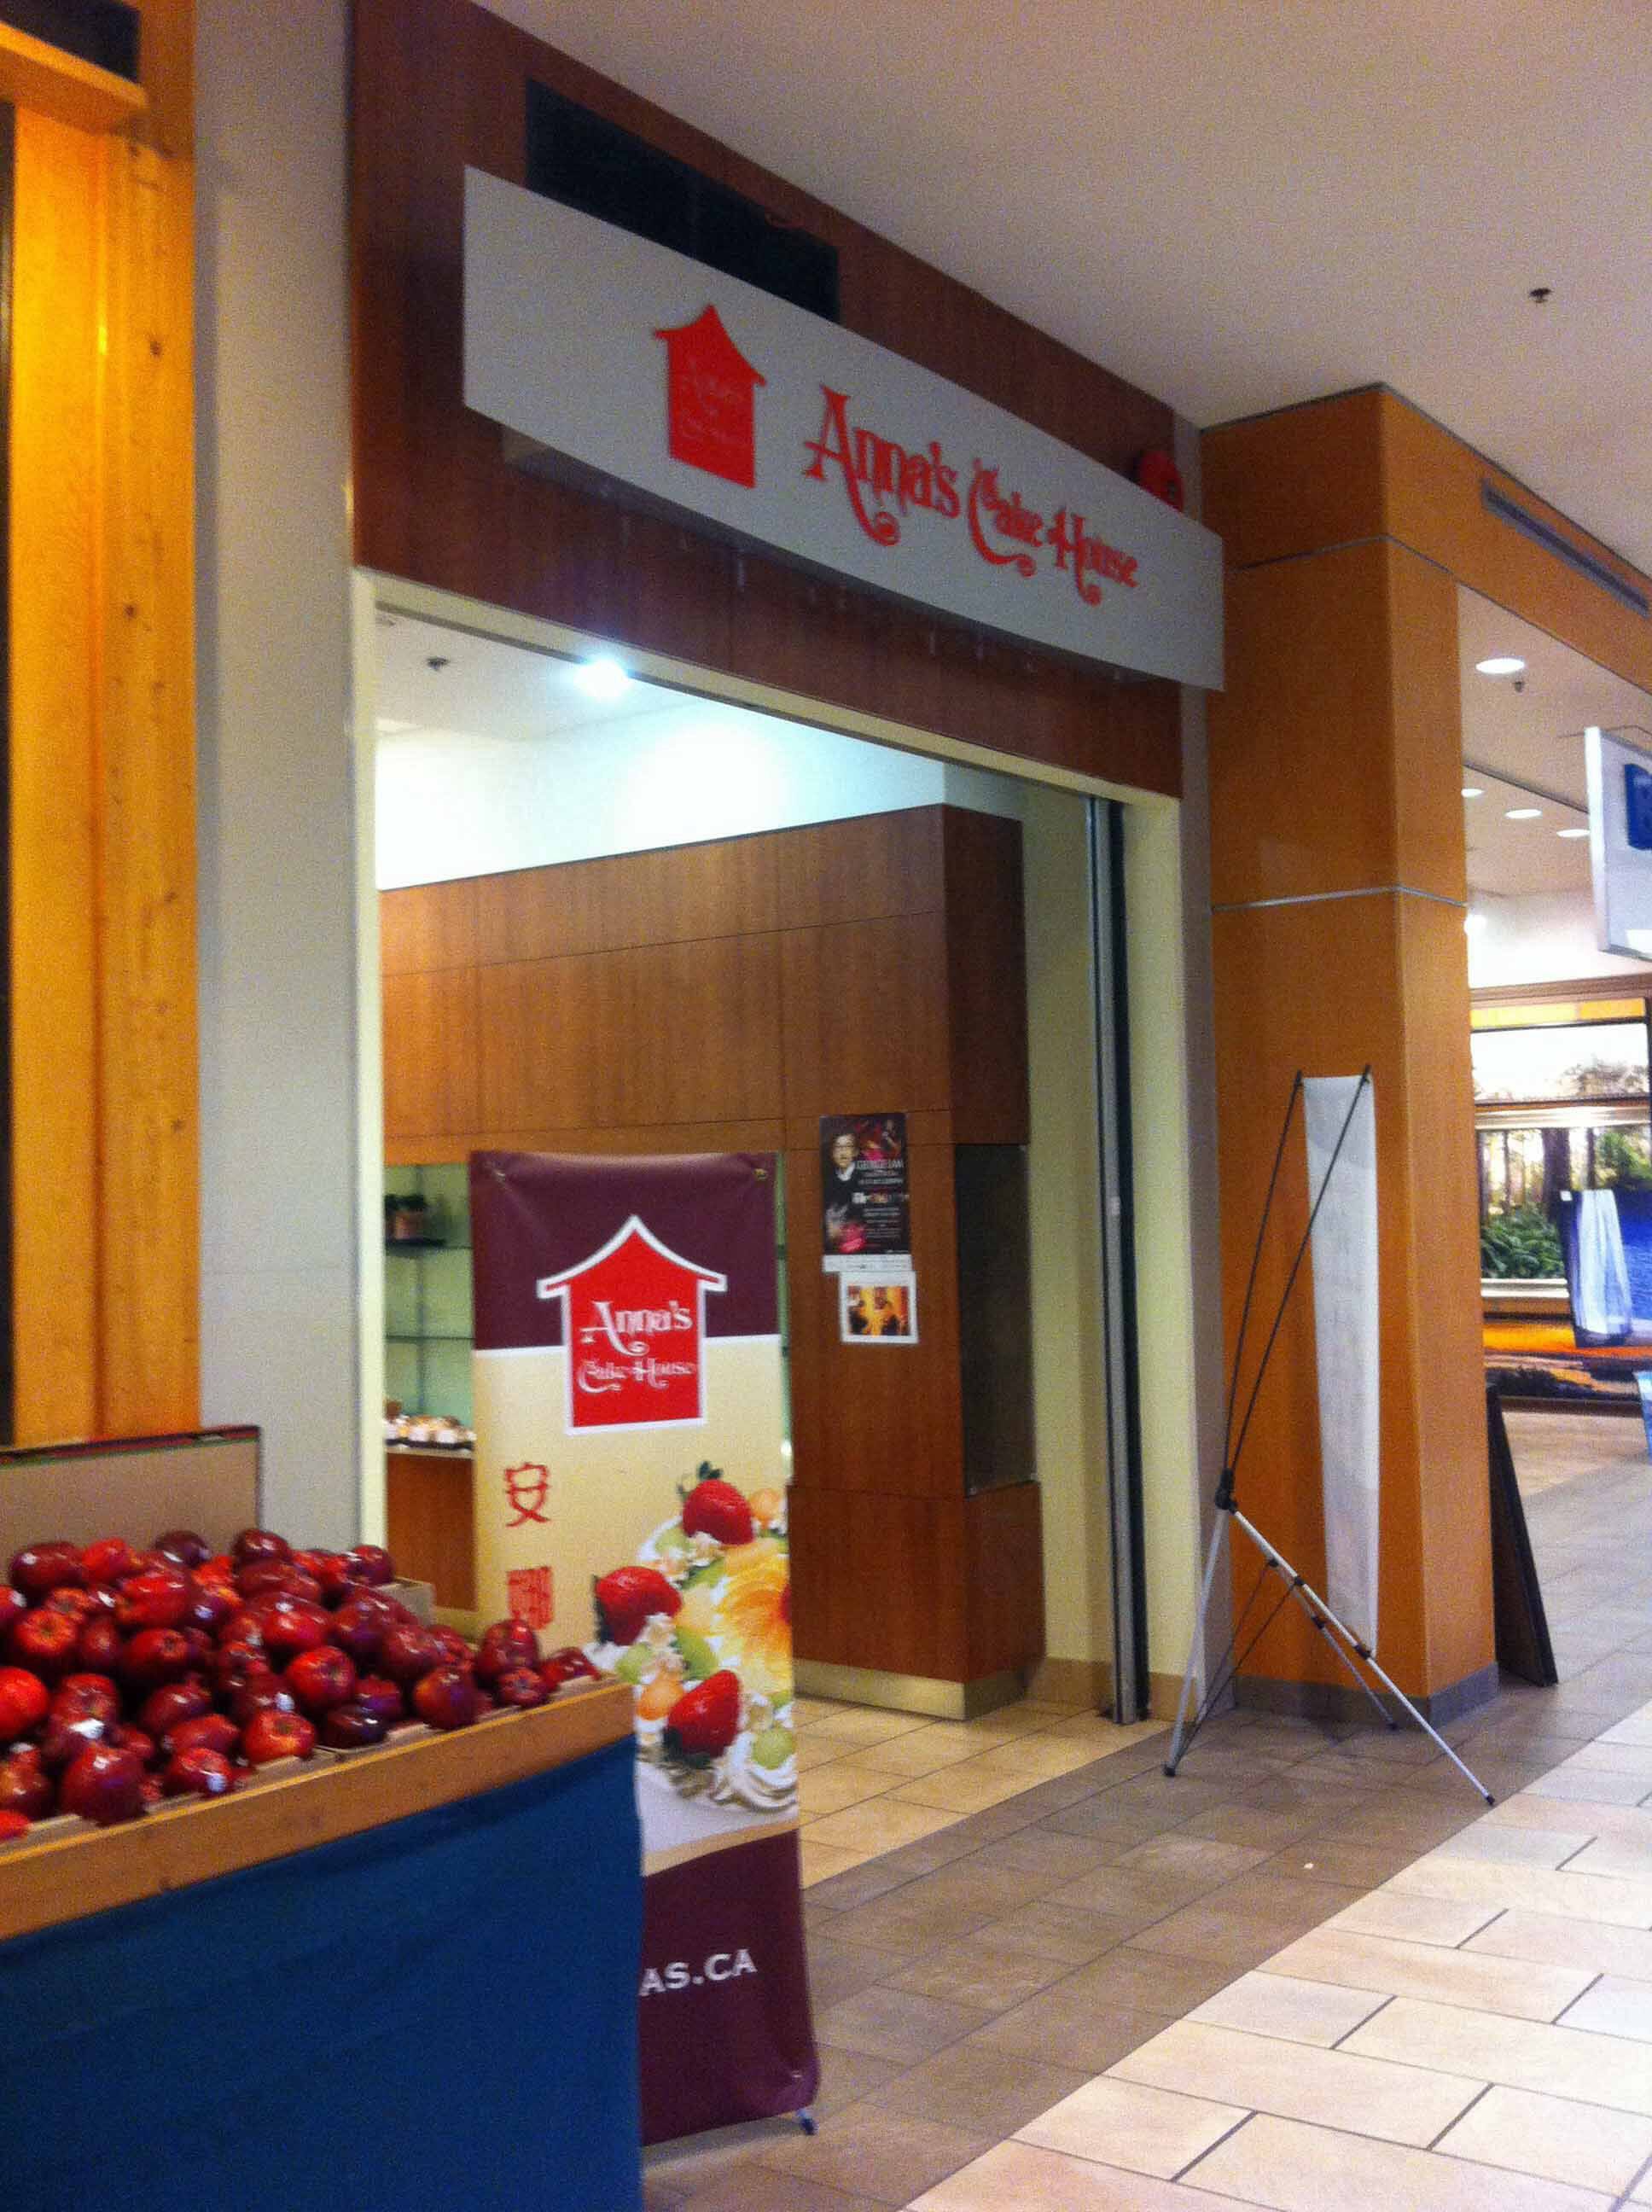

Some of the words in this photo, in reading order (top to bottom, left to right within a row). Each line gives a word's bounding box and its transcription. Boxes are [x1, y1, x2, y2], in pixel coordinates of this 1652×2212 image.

[804, 384, 961, 546] Anna's
[967, 458, 1044, 577] Cake
[1047, 507, 1138, 607] House
[580, 1300, 694, 1357] Anna's
[578, 1359, 627, 1394] Cake
[631, 1358, 696, 1390] House
